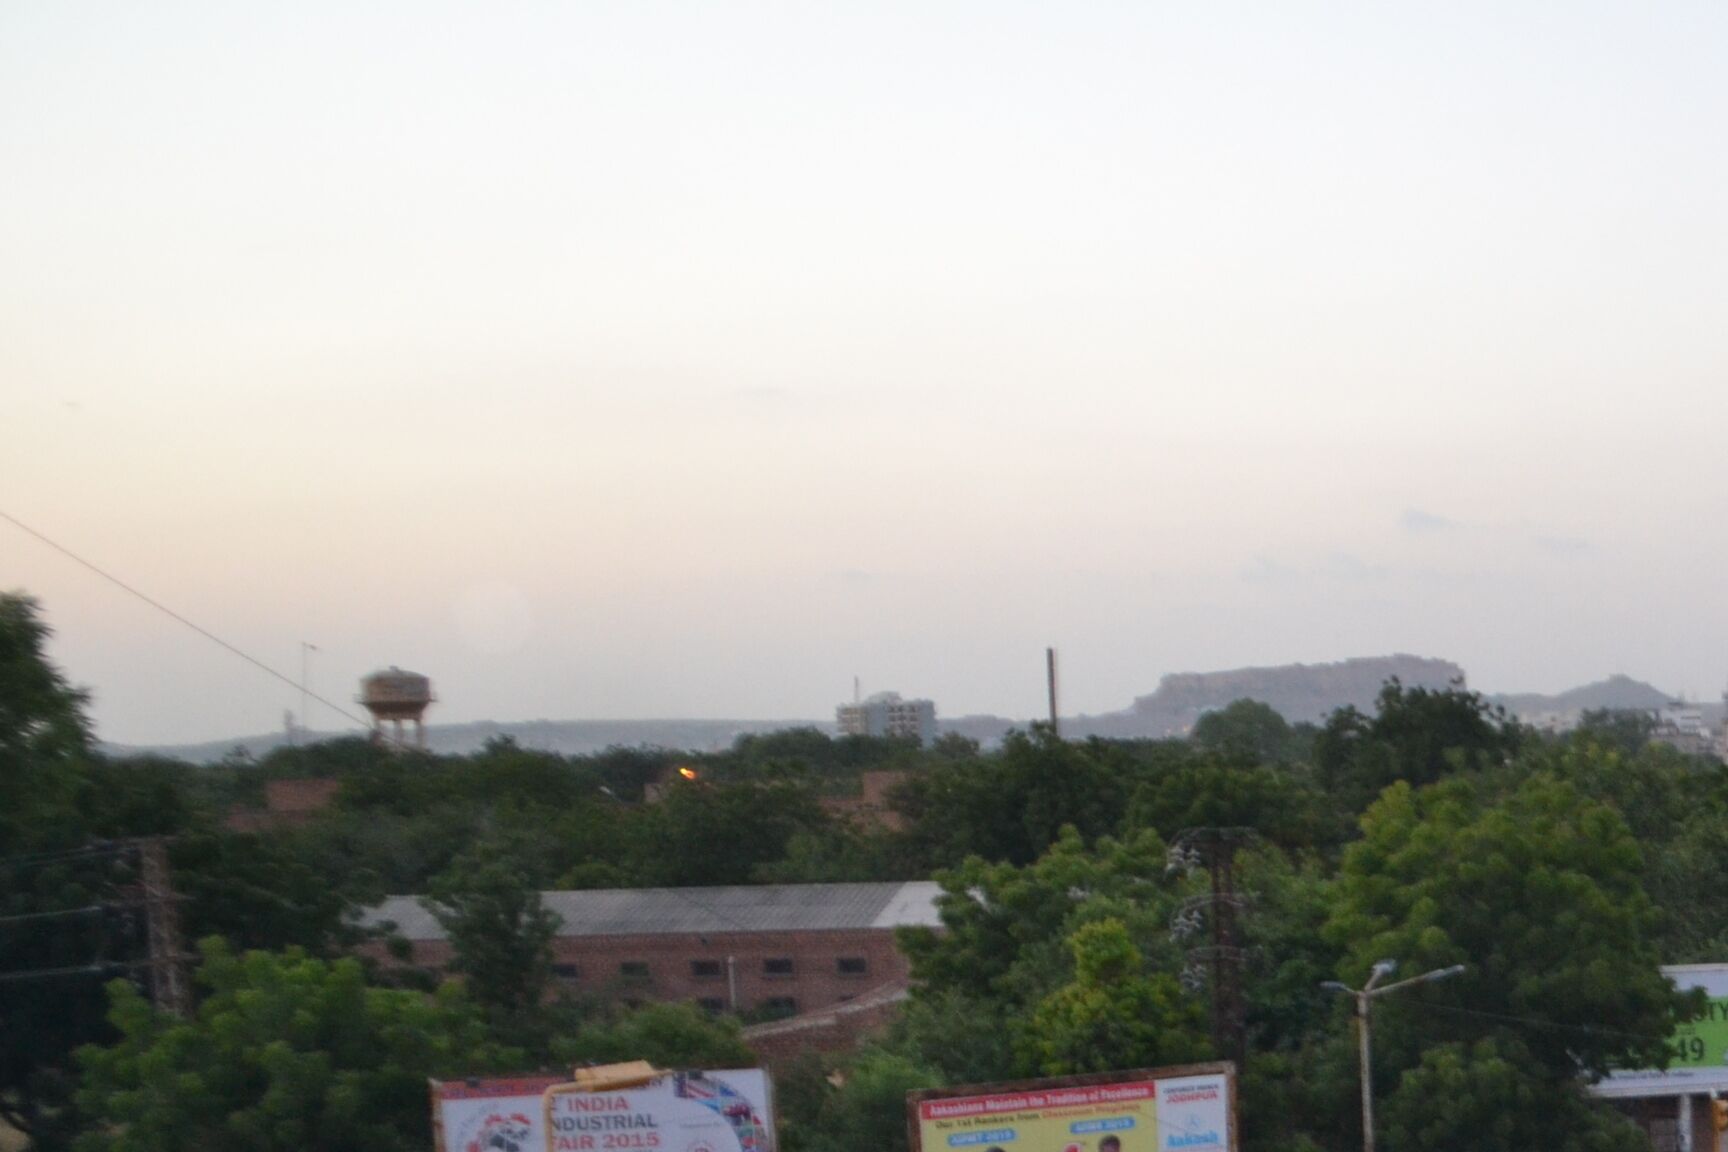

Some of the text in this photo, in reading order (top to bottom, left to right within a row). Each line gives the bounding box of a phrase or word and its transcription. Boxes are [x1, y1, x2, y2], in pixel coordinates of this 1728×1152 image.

[568, 1096, 630, 1112] INDIA
[552, 1113, 659, 1132] NDUSTRIAL
[603, 1132, 661, 1149] 2015
